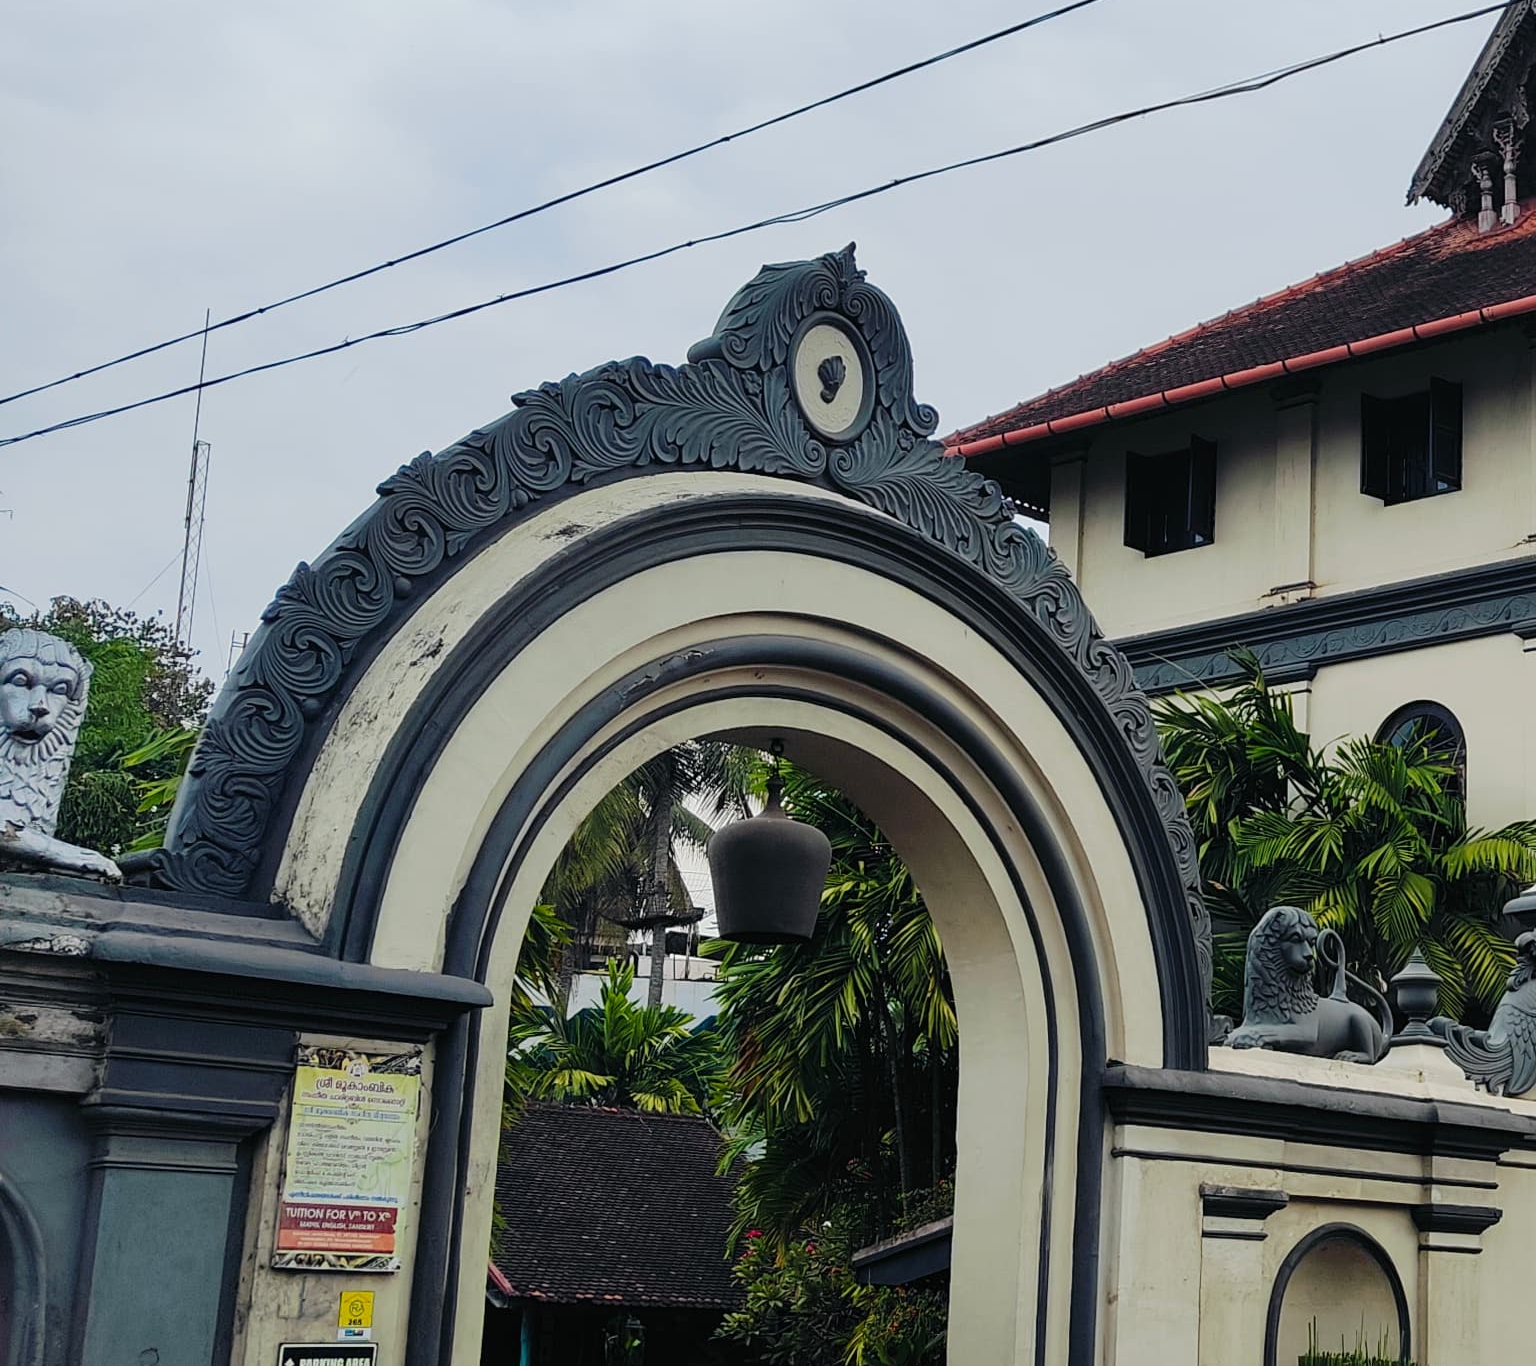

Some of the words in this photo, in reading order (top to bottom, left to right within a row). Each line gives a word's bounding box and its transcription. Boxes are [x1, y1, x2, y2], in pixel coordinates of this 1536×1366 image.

[286, 1207, 324, 1219] TUITION
[325, 1209, 345, 1220] FOR
[363, 1211, 376, 1221] TO
